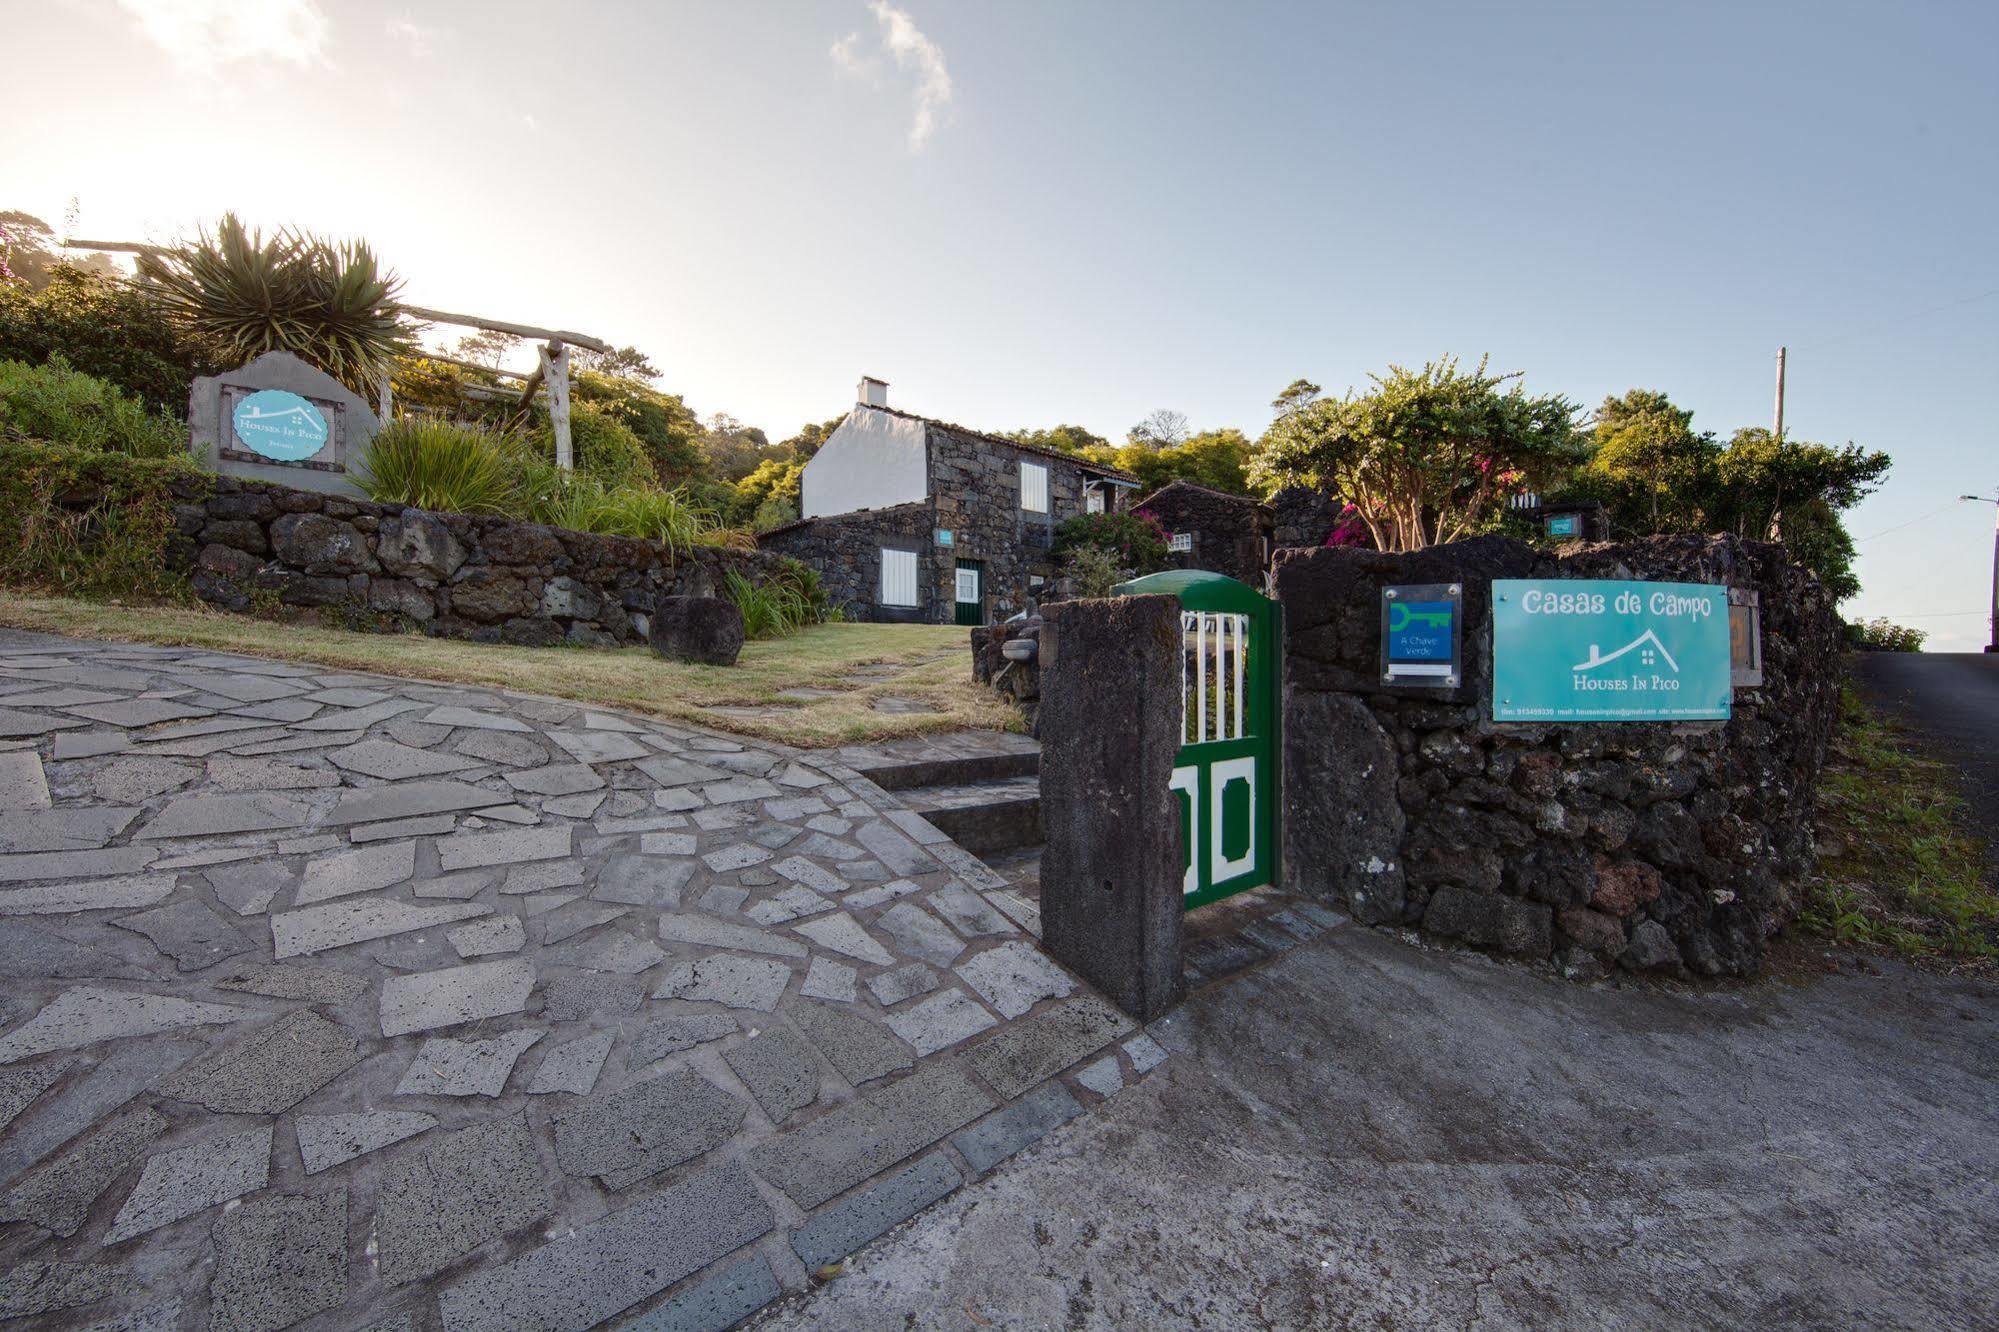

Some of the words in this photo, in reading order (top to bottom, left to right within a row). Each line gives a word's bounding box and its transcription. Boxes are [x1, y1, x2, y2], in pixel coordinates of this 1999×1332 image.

[1521, 589, 1606, 614] Casas
[1614, 590, 1642, 614] de
[1650, 591, 1712, 623] Campo
